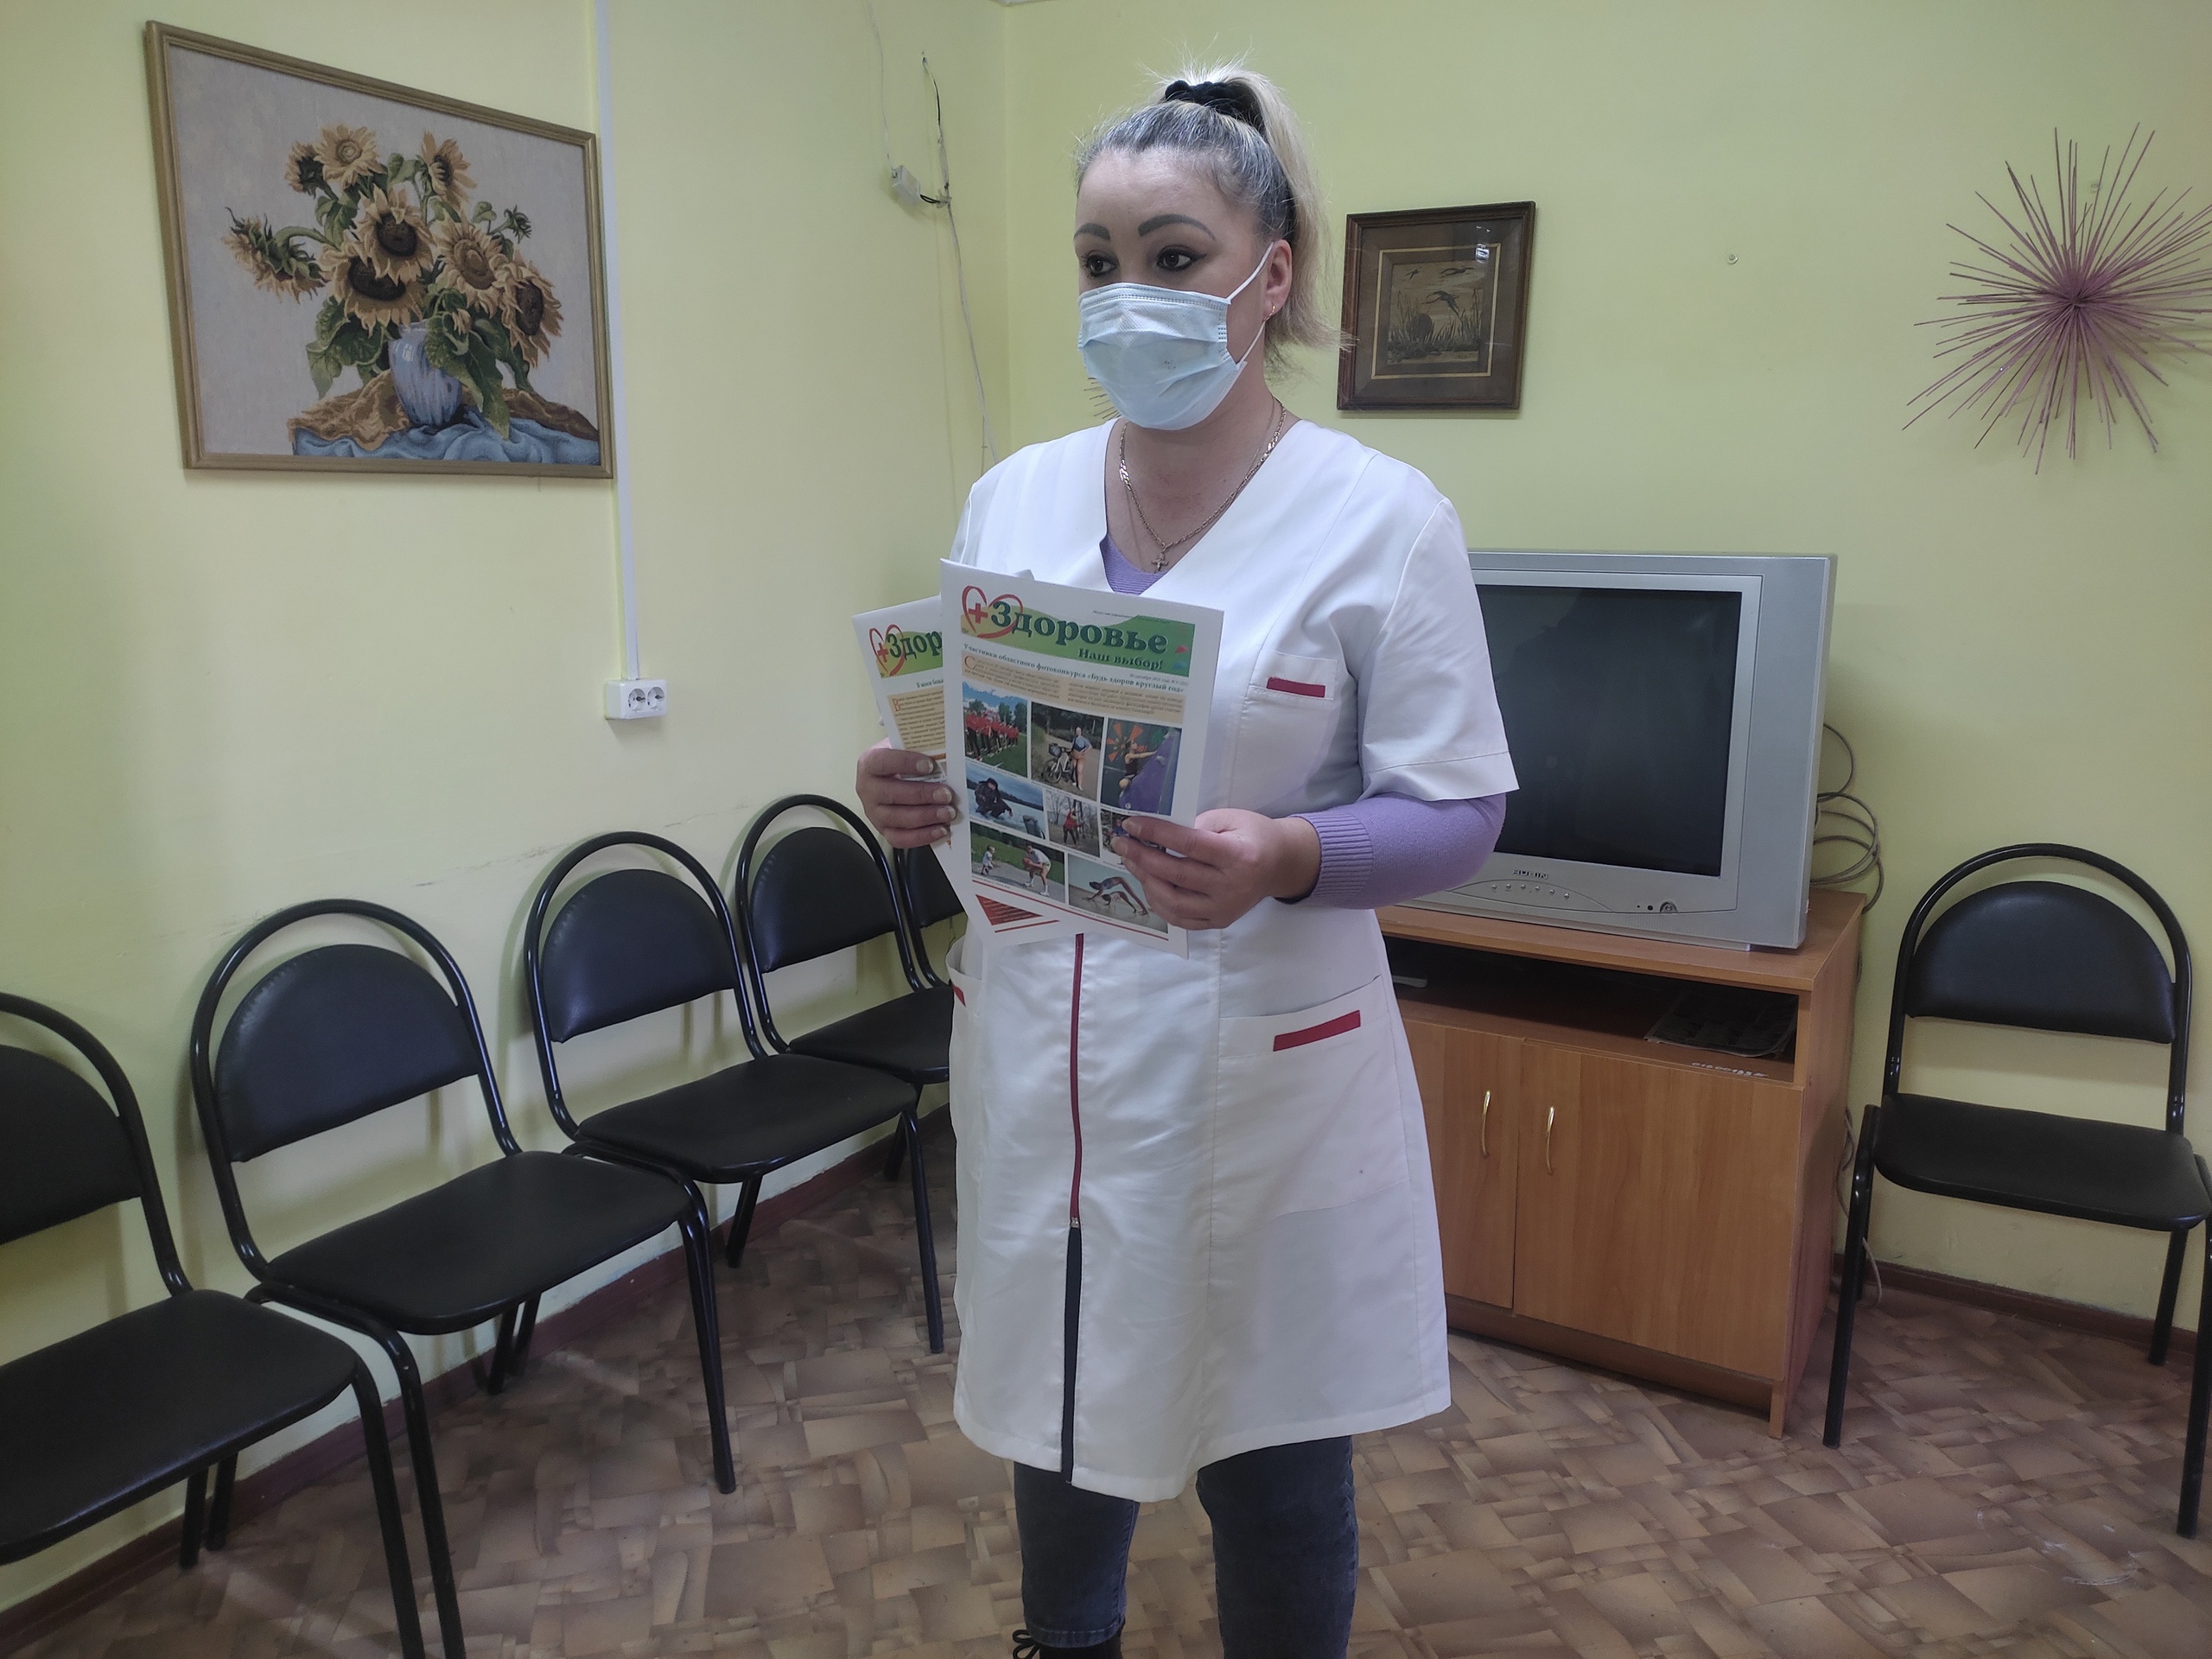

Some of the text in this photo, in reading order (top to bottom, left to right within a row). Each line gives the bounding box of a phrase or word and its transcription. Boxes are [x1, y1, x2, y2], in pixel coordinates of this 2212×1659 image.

[991, 601, 1167, 654] Здоровье
[963, 643, 998, 658] Участники
[998, 654, 1035, 668] областного
[1036, 663, 1086, 679] фотоконкурса
[1135, 680, 1167, 690] круглый
[1078, 648, 1164, 671] Наш выбор!
